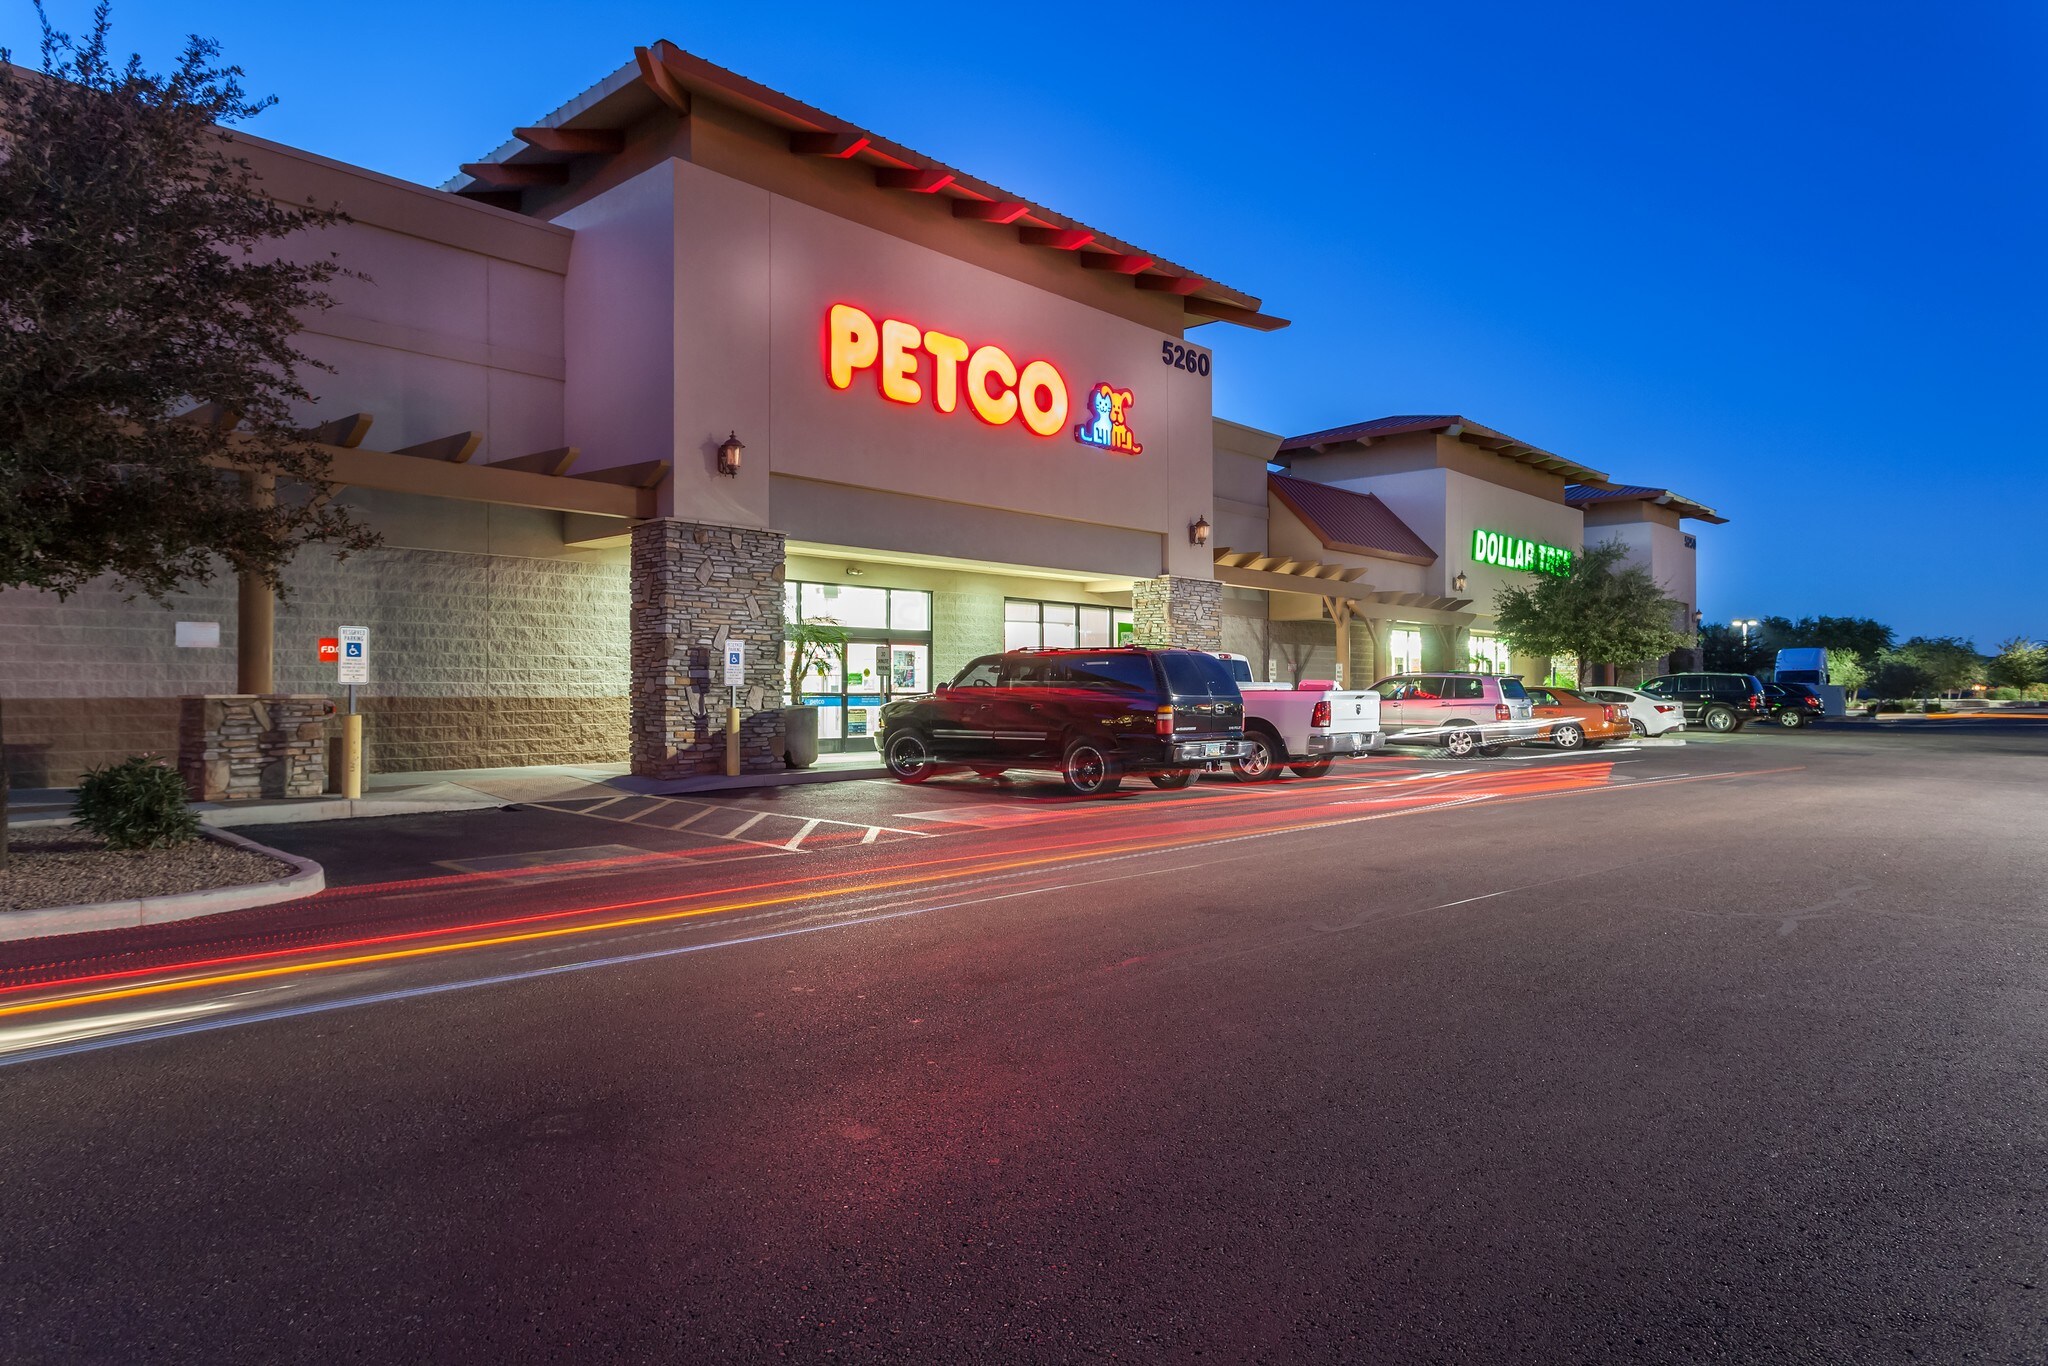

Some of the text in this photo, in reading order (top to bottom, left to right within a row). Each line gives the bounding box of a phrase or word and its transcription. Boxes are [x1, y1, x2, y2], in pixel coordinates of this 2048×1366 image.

[826, 303, 1068, 436] PETCO
[1162, 340, 1210, 377] 5260
[1472, 529, 1535, 571] DOLLAR
